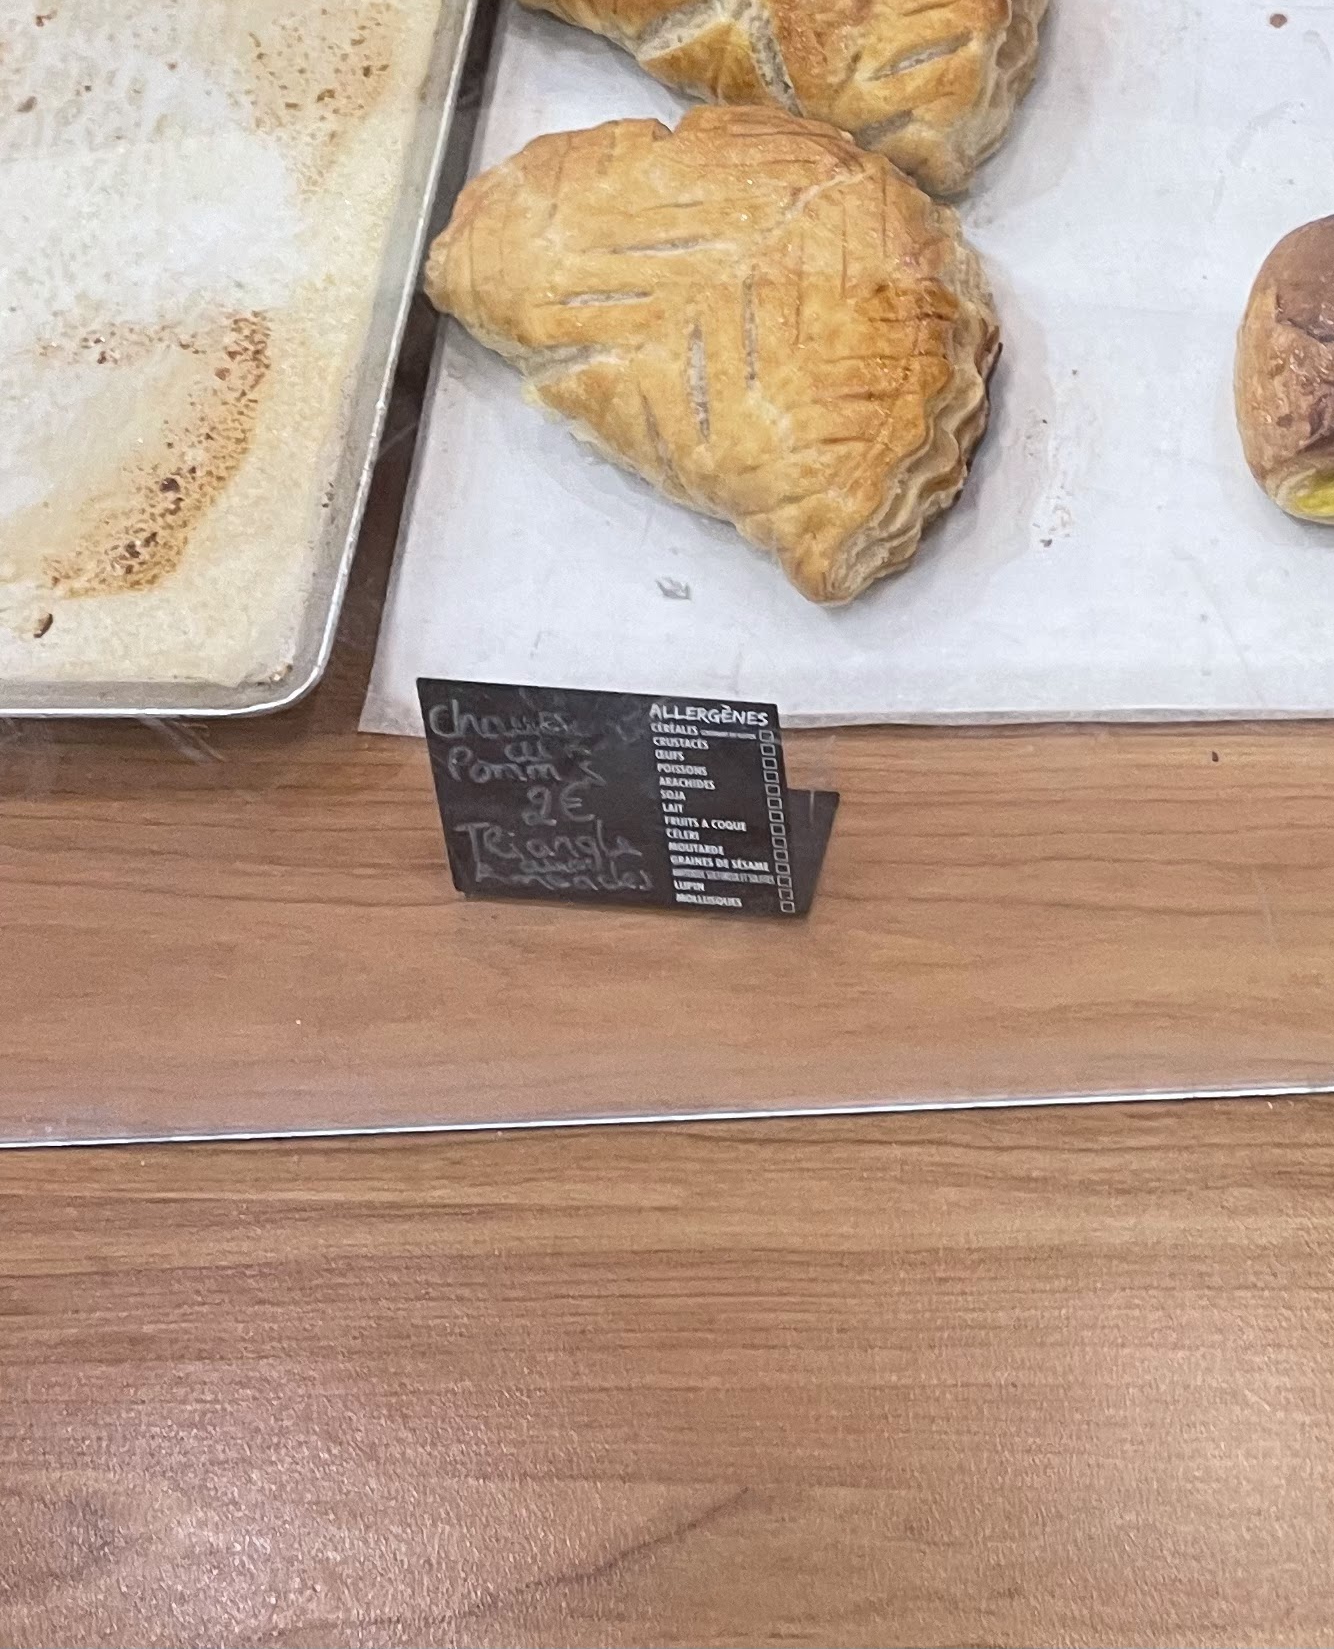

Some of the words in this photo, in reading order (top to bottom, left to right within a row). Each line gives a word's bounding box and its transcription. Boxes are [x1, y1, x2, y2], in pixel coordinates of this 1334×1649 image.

[649, 703, 769, 727] ALLERGÈNES
[656, 762, 709, 777] POISSONS
[659, 776, 717, 791] ARACHIDES
[660, 789, 686, 802] SOJA
[661, 802, 684, 814] LAIT
[664, 815, 700, 828] FRUITS
[711, 819, 748, 832] COQUE
[668, 841, 725, 856] MOUTARDE
[670, 854, 715, 868] GRAINES
[715, 858, 730, 869] DE
[673, 880, 706, 892] LUPIN
[676, 892, 743, 908] MOLLUSQUES
